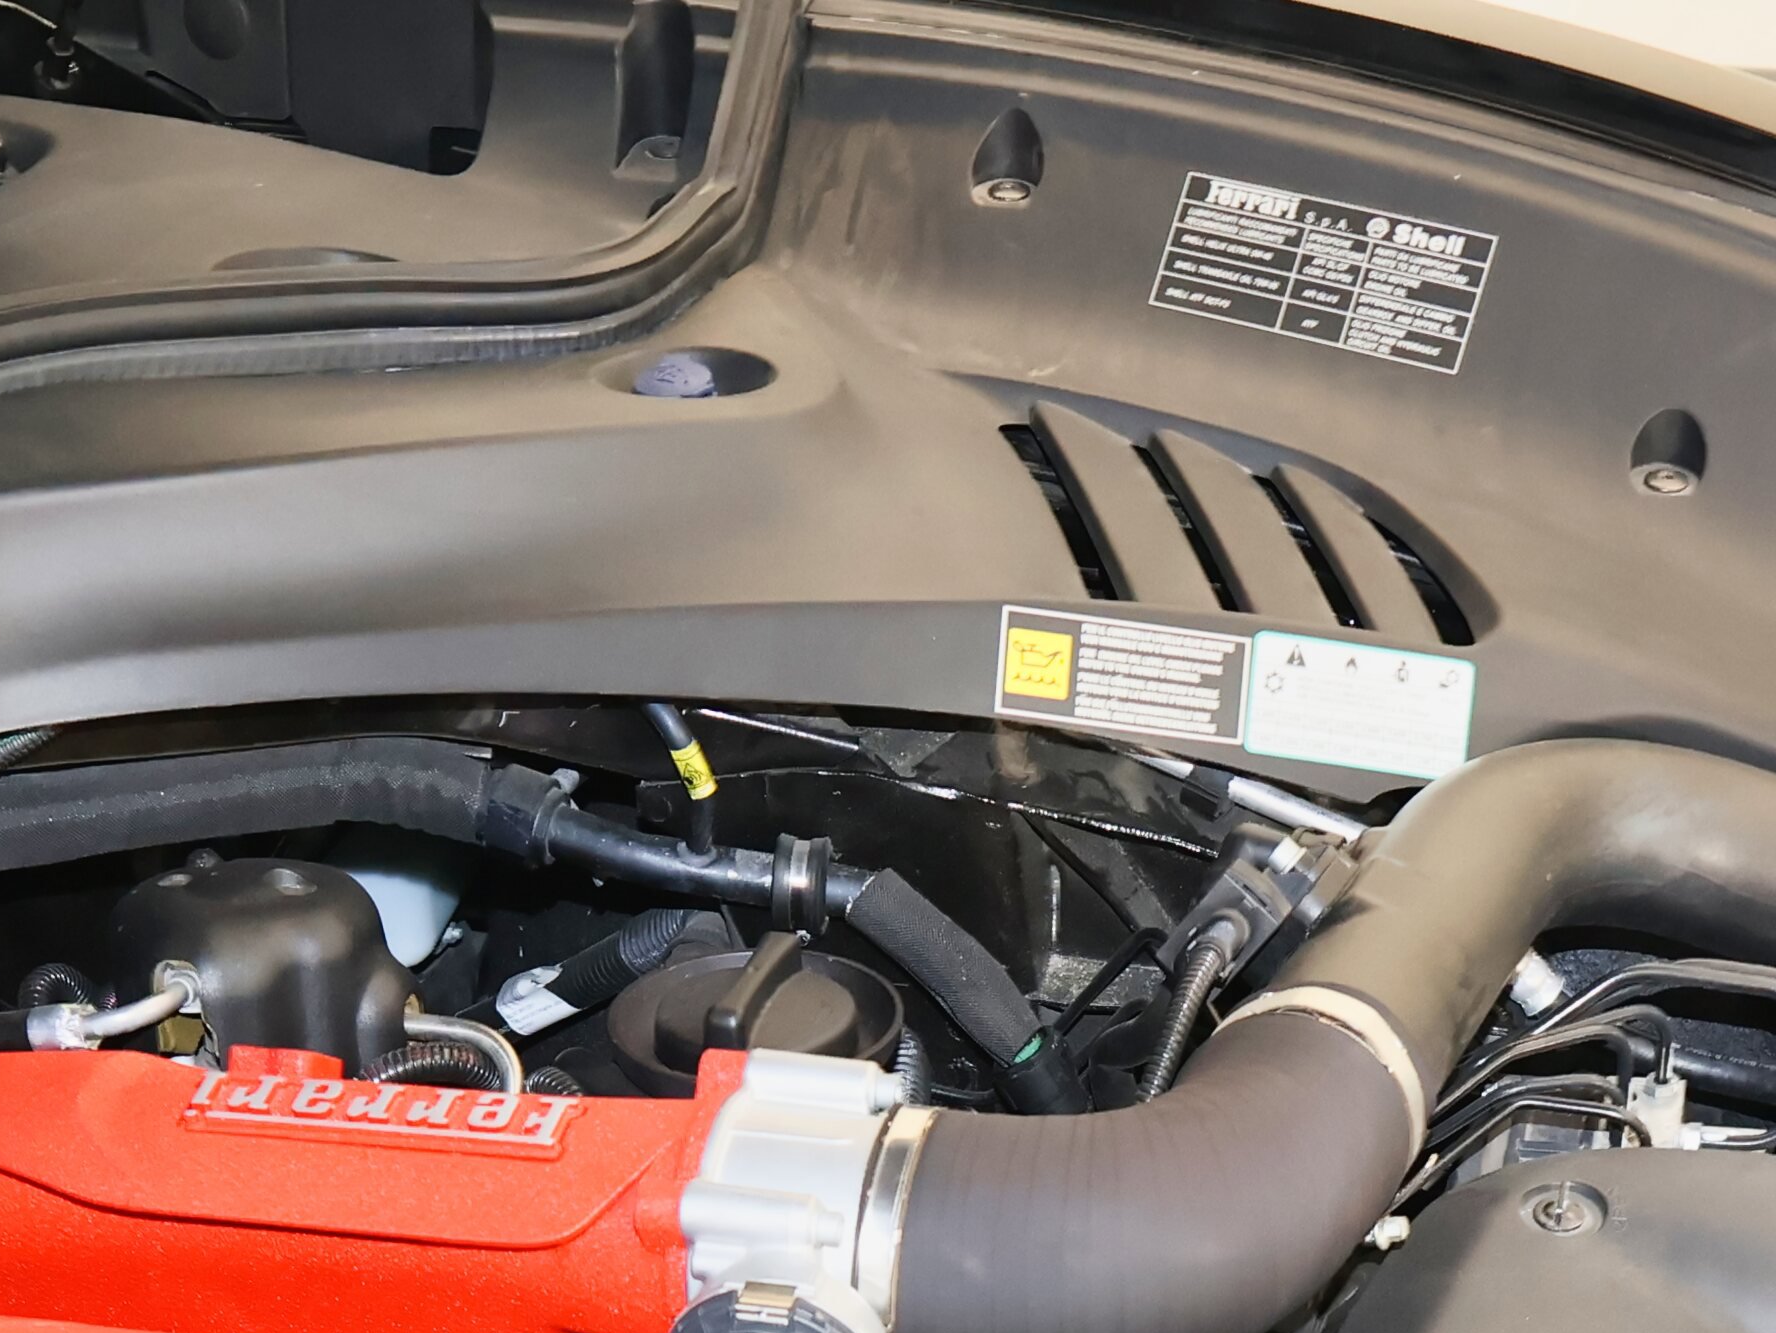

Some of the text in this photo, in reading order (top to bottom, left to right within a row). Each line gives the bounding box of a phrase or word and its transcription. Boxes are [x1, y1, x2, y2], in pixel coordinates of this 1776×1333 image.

[1206, 180, 1300, 219] Ferrari
[1393, 223, 1465, 256] Shell
[184, 1070, 580, 1146] Ferrari
